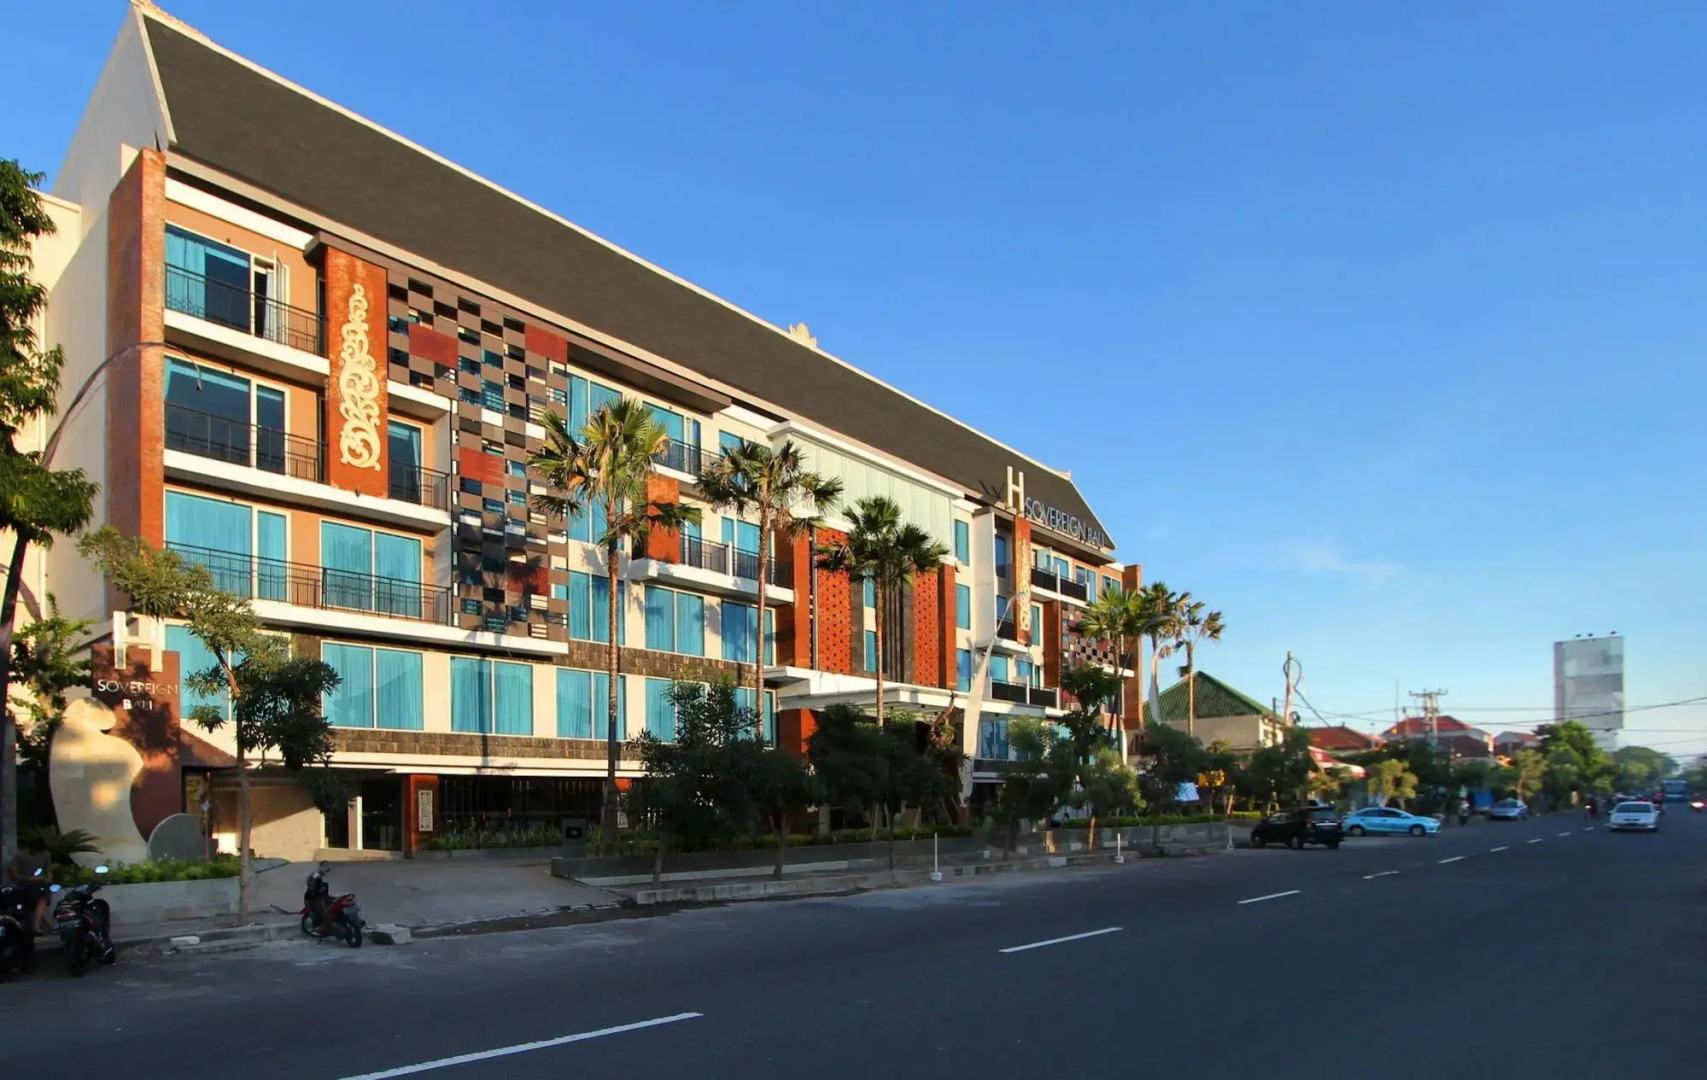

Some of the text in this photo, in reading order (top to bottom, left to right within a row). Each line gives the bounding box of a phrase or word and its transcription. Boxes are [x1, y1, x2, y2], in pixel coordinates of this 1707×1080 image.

[1007, 465, 1105, 549] H SOVEREIGN BALI
[113, 611, 163, 672] H
[97, 679, 178, 696] SOVEREIGN
[123, 699, 153, 711] BALI
